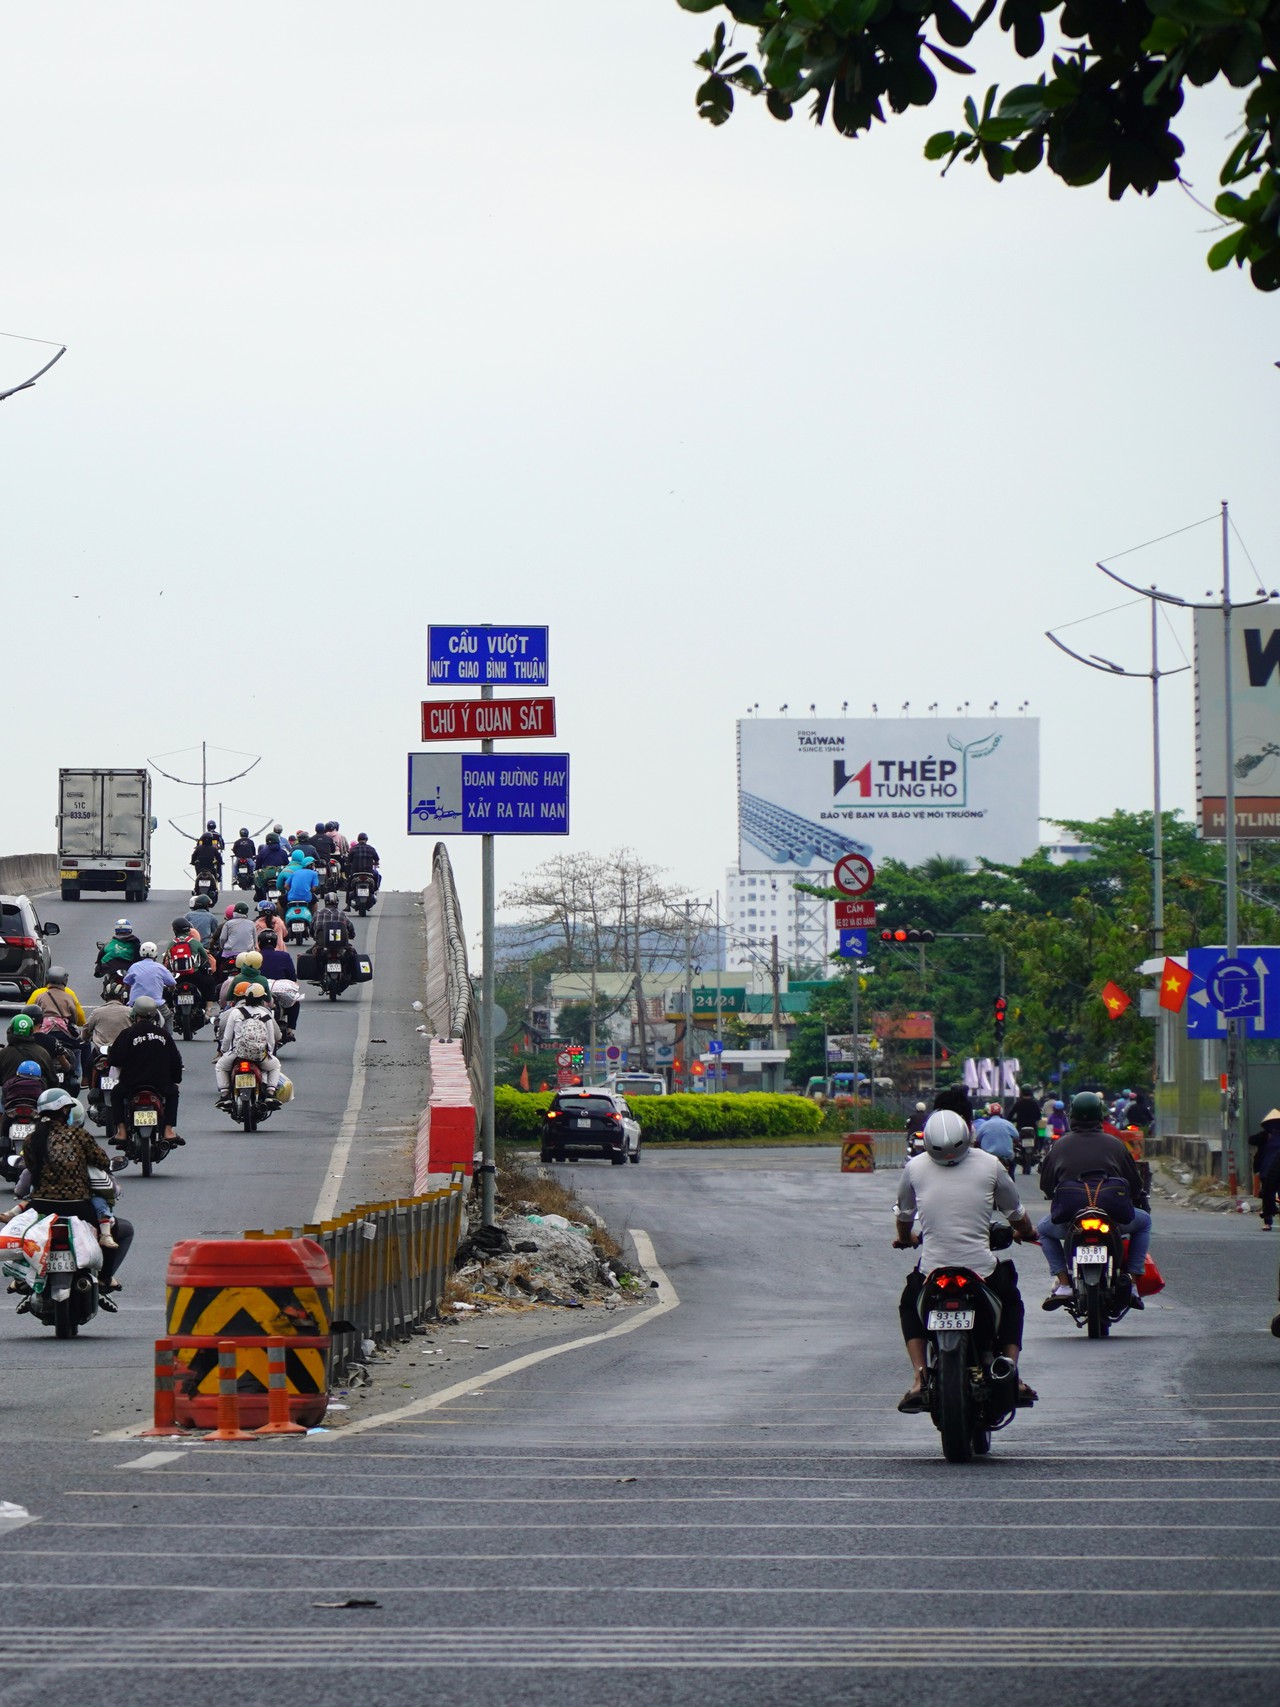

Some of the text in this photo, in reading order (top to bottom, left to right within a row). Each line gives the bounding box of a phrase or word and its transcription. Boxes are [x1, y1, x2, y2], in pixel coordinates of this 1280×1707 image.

[448, 629, 529, 657] CẦU VƯỢT
[431, 656, 545, 682] NÚT GIAO BÌNH THUẬN
[430, 700, 544, 734] CHÚ Ý QUAN SÁT
[798, 736, 845, 745] TAIWAN
[463, 766, 566, 789] ĐOẠN ĐƯỜNG HAY
[877, 755, 957, 782] THÉP
[874, 783, 957, 798] TUNG HO
[74, 801, 86, 809] 51C
[497, 802, 513, 818] RA
[517, 802, 535, 818] TAI
[540, 802, 565, 820] NẠN
[1213, 813, 1280, 827] HTLINE
